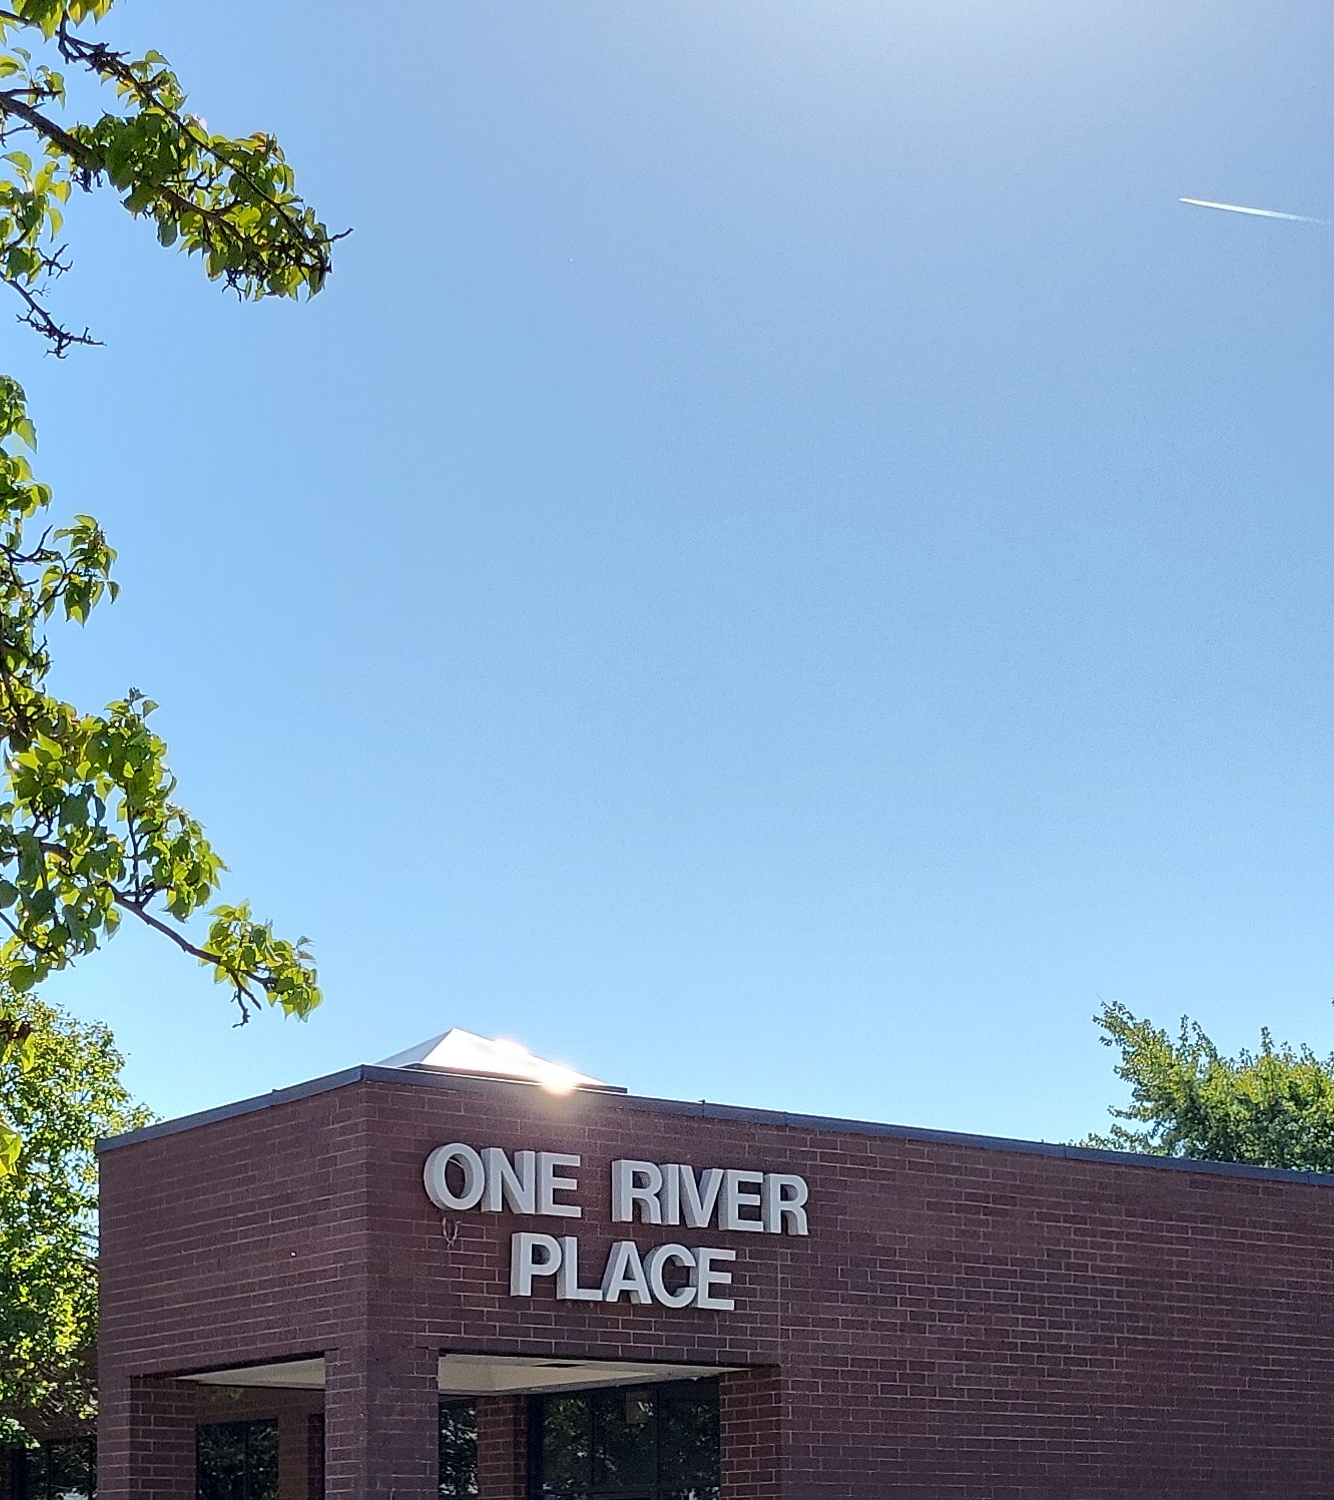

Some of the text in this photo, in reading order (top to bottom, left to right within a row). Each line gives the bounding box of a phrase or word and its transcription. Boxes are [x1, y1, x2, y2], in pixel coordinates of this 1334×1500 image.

[424, 1142, 809, 1236] ONE RIVER
[510, 1232, 736, 1311] PLACE
